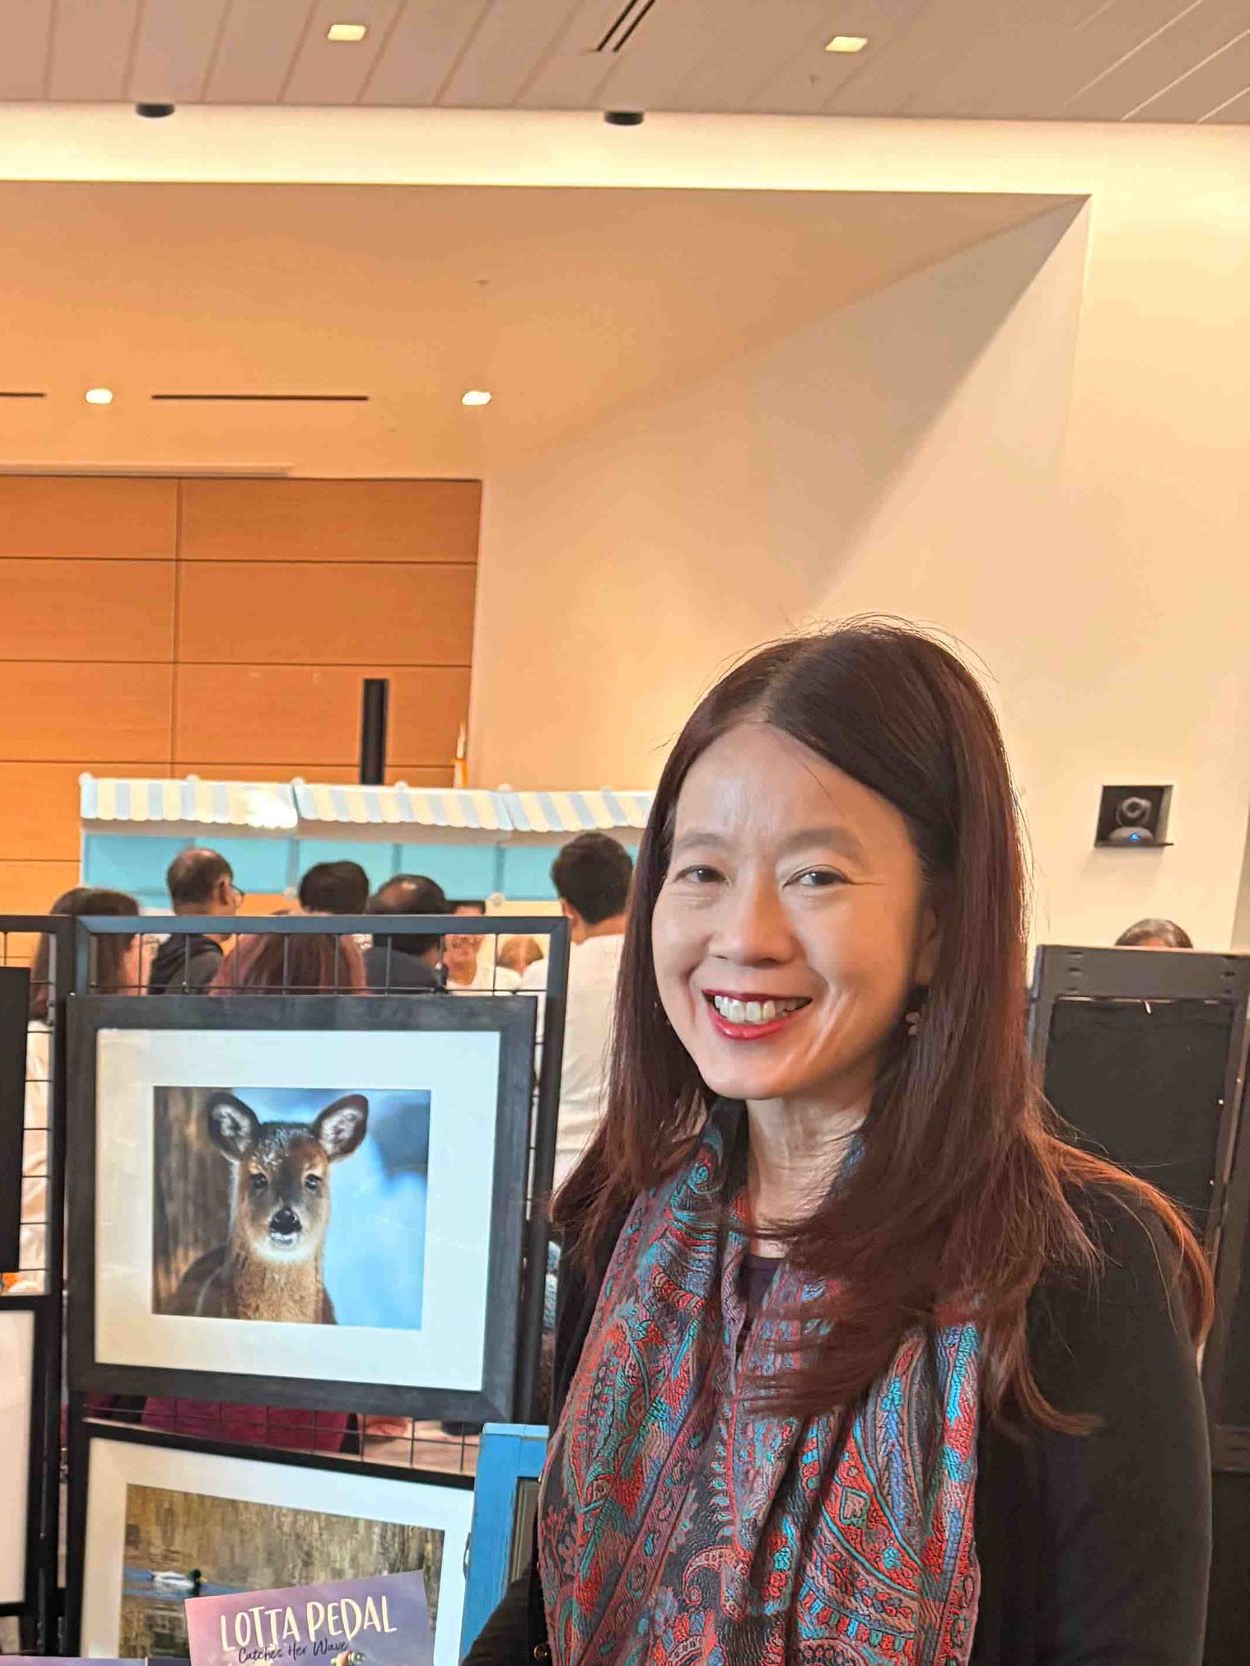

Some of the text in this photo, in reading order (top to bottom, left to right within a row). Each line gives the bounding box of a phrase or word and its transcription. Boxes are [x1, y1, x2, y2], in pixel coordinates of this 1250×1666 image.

[219, 1595, 398, 1652] LOTTA PEDAL
[238, 1637, 349, 1664] Catches Her Wave
